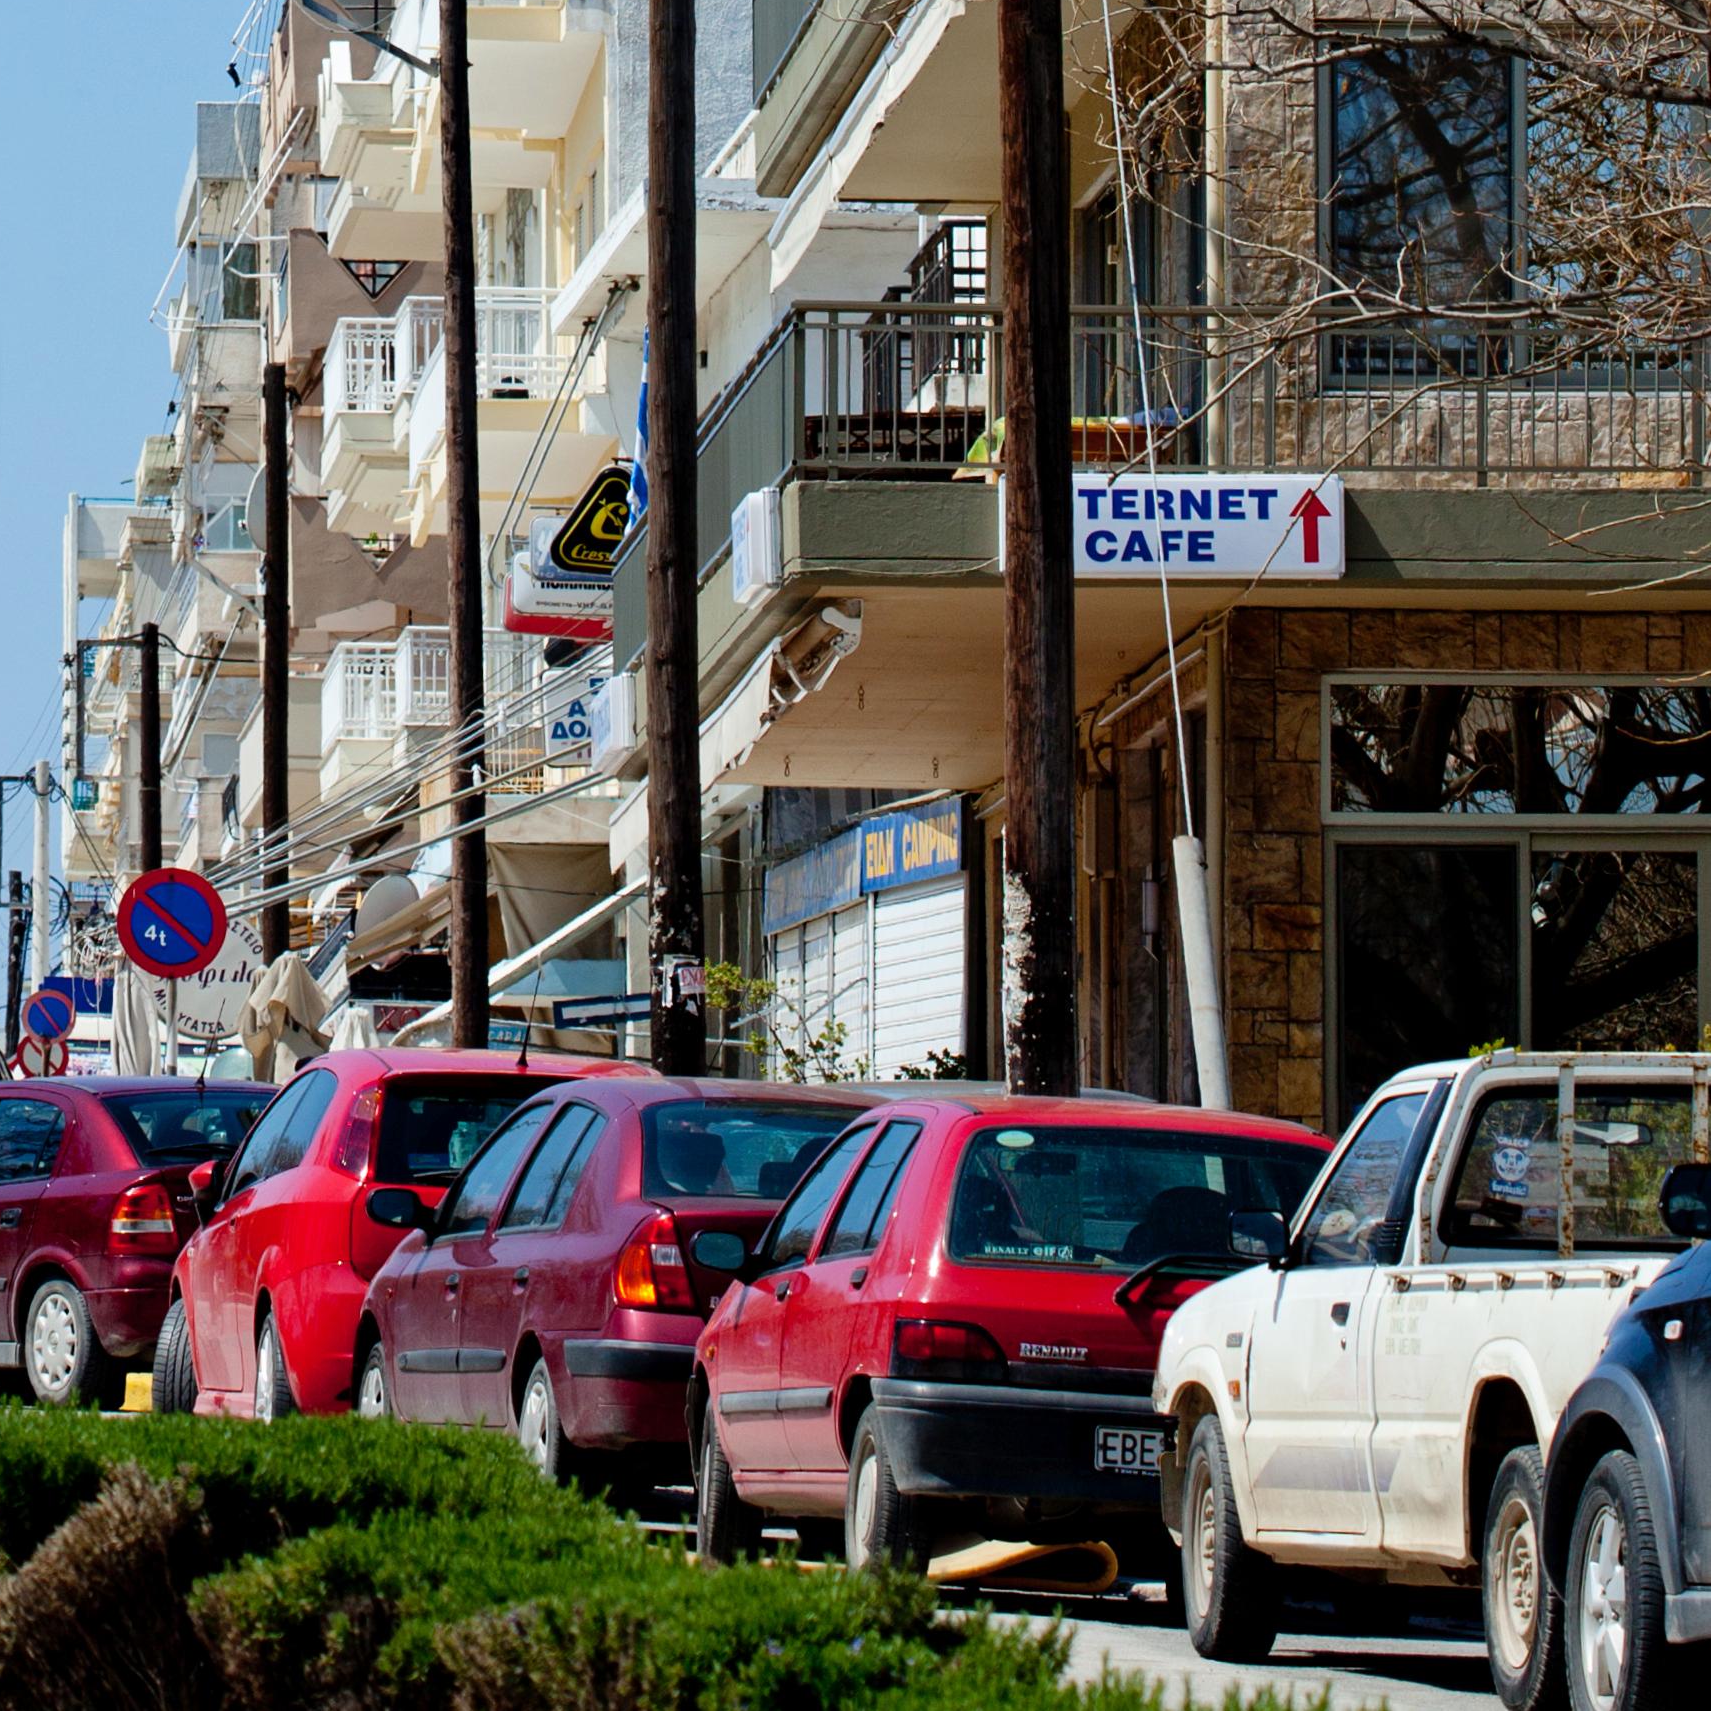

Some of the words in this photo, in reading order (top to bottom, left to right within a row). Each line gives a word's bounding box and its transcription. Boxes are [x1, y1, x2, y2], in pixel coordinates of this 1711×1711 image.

[1077, 488, 1279, 520] TERNET
[1085, 530, 1216, 563] CAFE
[902, 811, 959, 872] CAMPING
[1020, 1343, 1088, 1361] RENAULT
